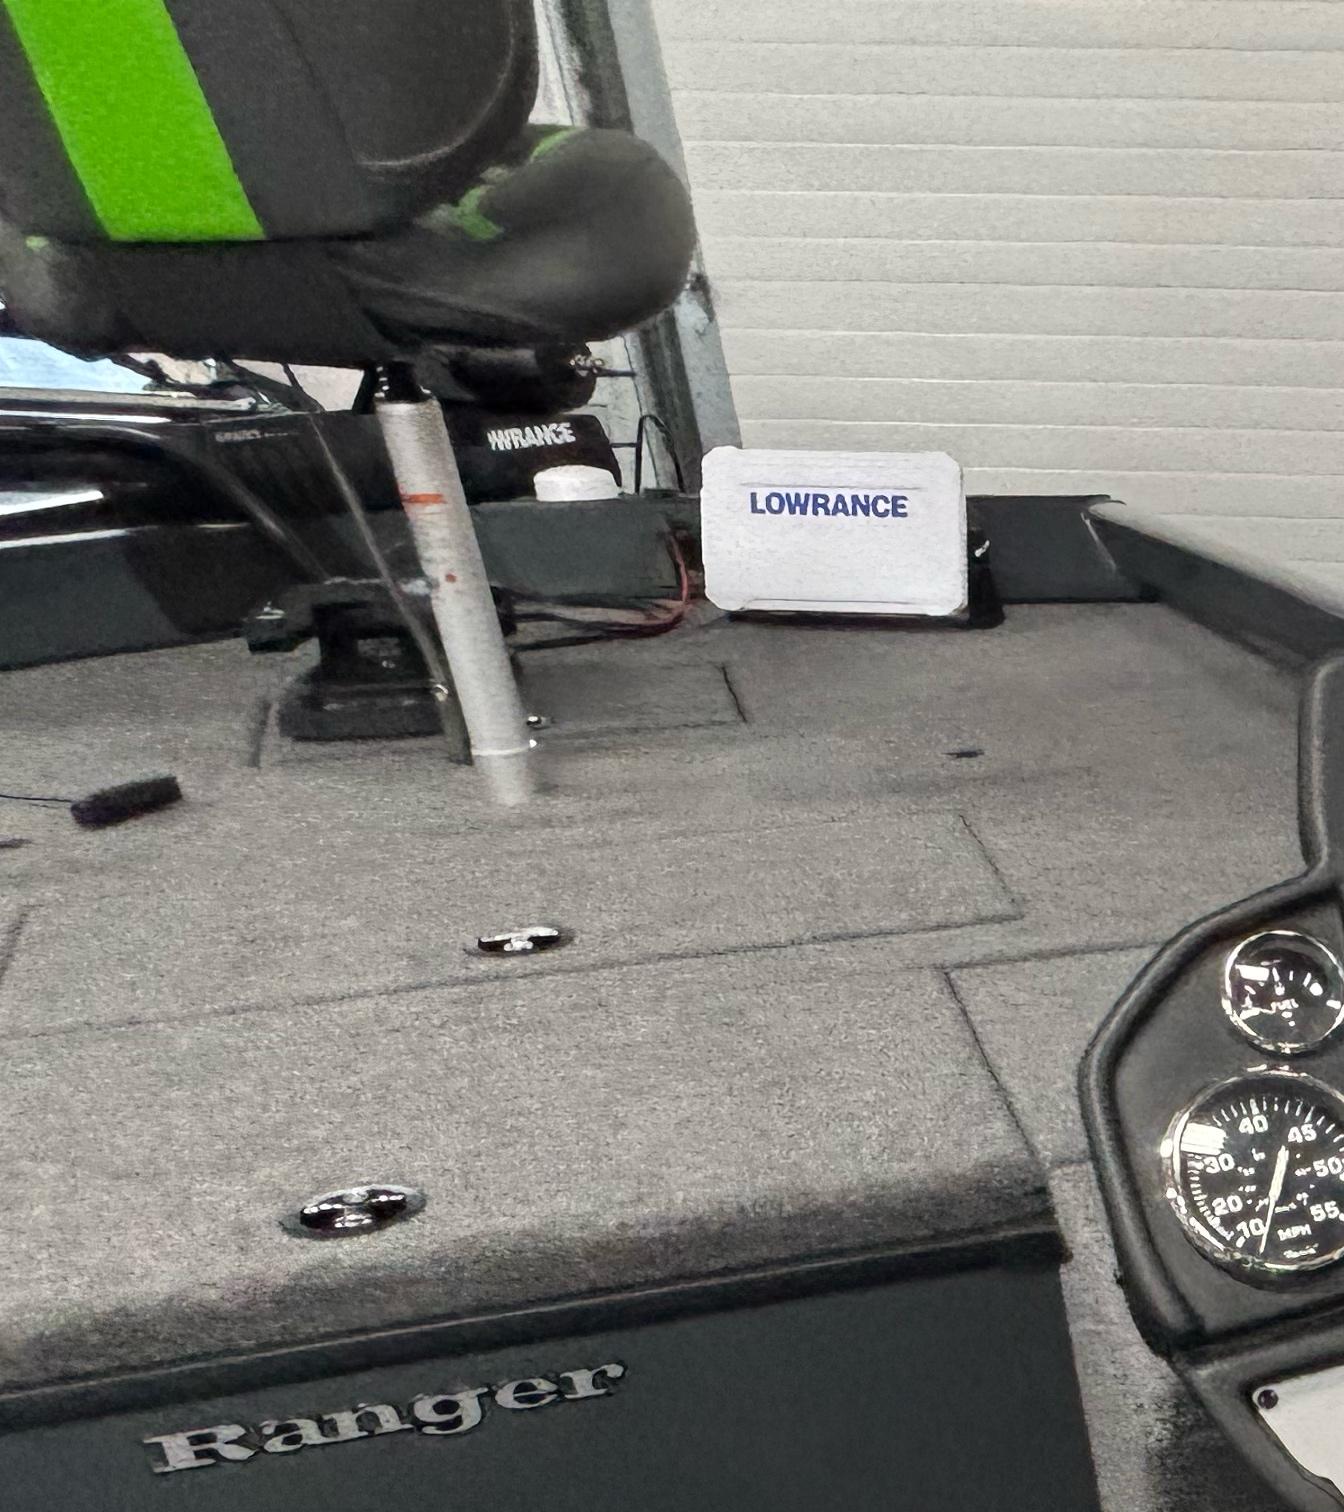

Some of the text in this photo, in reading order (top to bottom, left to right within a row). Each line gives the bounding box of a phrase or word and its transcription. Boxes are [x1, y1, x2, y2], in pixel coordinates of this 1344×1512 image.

[749, 491, 909, 518] LOWRANCE
[1238, 1114, 1269, 1135] 40
[1287, 1123, 1318, 1143] 45
[1203, 1152, 1236, 1174] 30
[1312, 1155, 1344, 1178] 50
[1211, 1194, 1243, 1216] 20
[1309, 1199, 1340, 1222] 55
[1235, 1217, 1266, 1239] 10
[143, 1361, 626, 1474] Ranger
